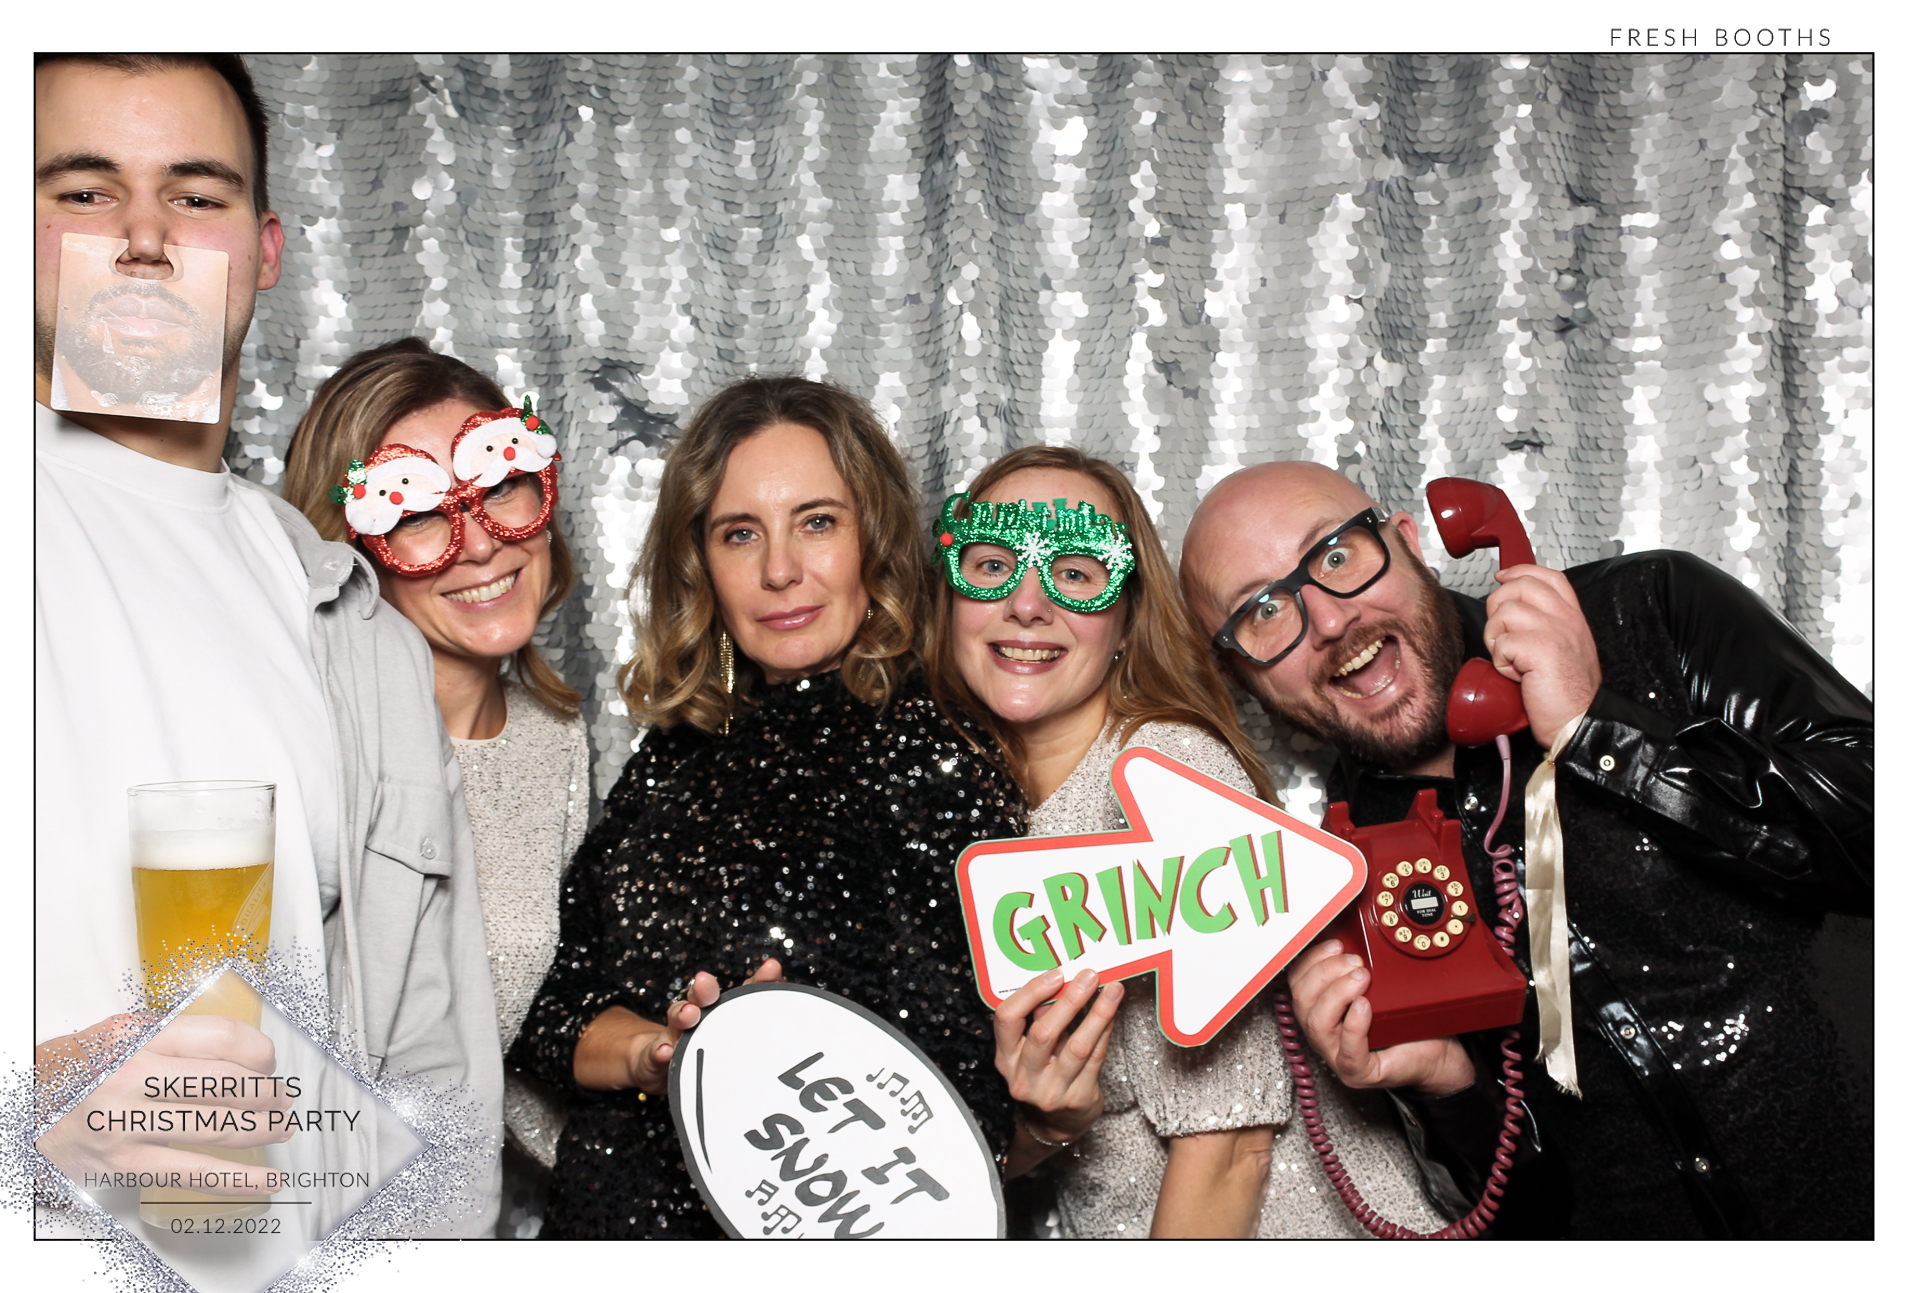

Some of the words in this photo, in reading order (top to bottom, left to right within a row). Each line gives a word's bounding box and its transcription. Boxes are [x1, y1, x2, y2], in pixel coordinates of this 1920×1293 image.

[992, 829, 1290, 972] GRINCH
[743, 1113, 885, 1239] SNOW
[778, 1051, 886, 1134] LET
[860, 1146, 950, 1205] IT
